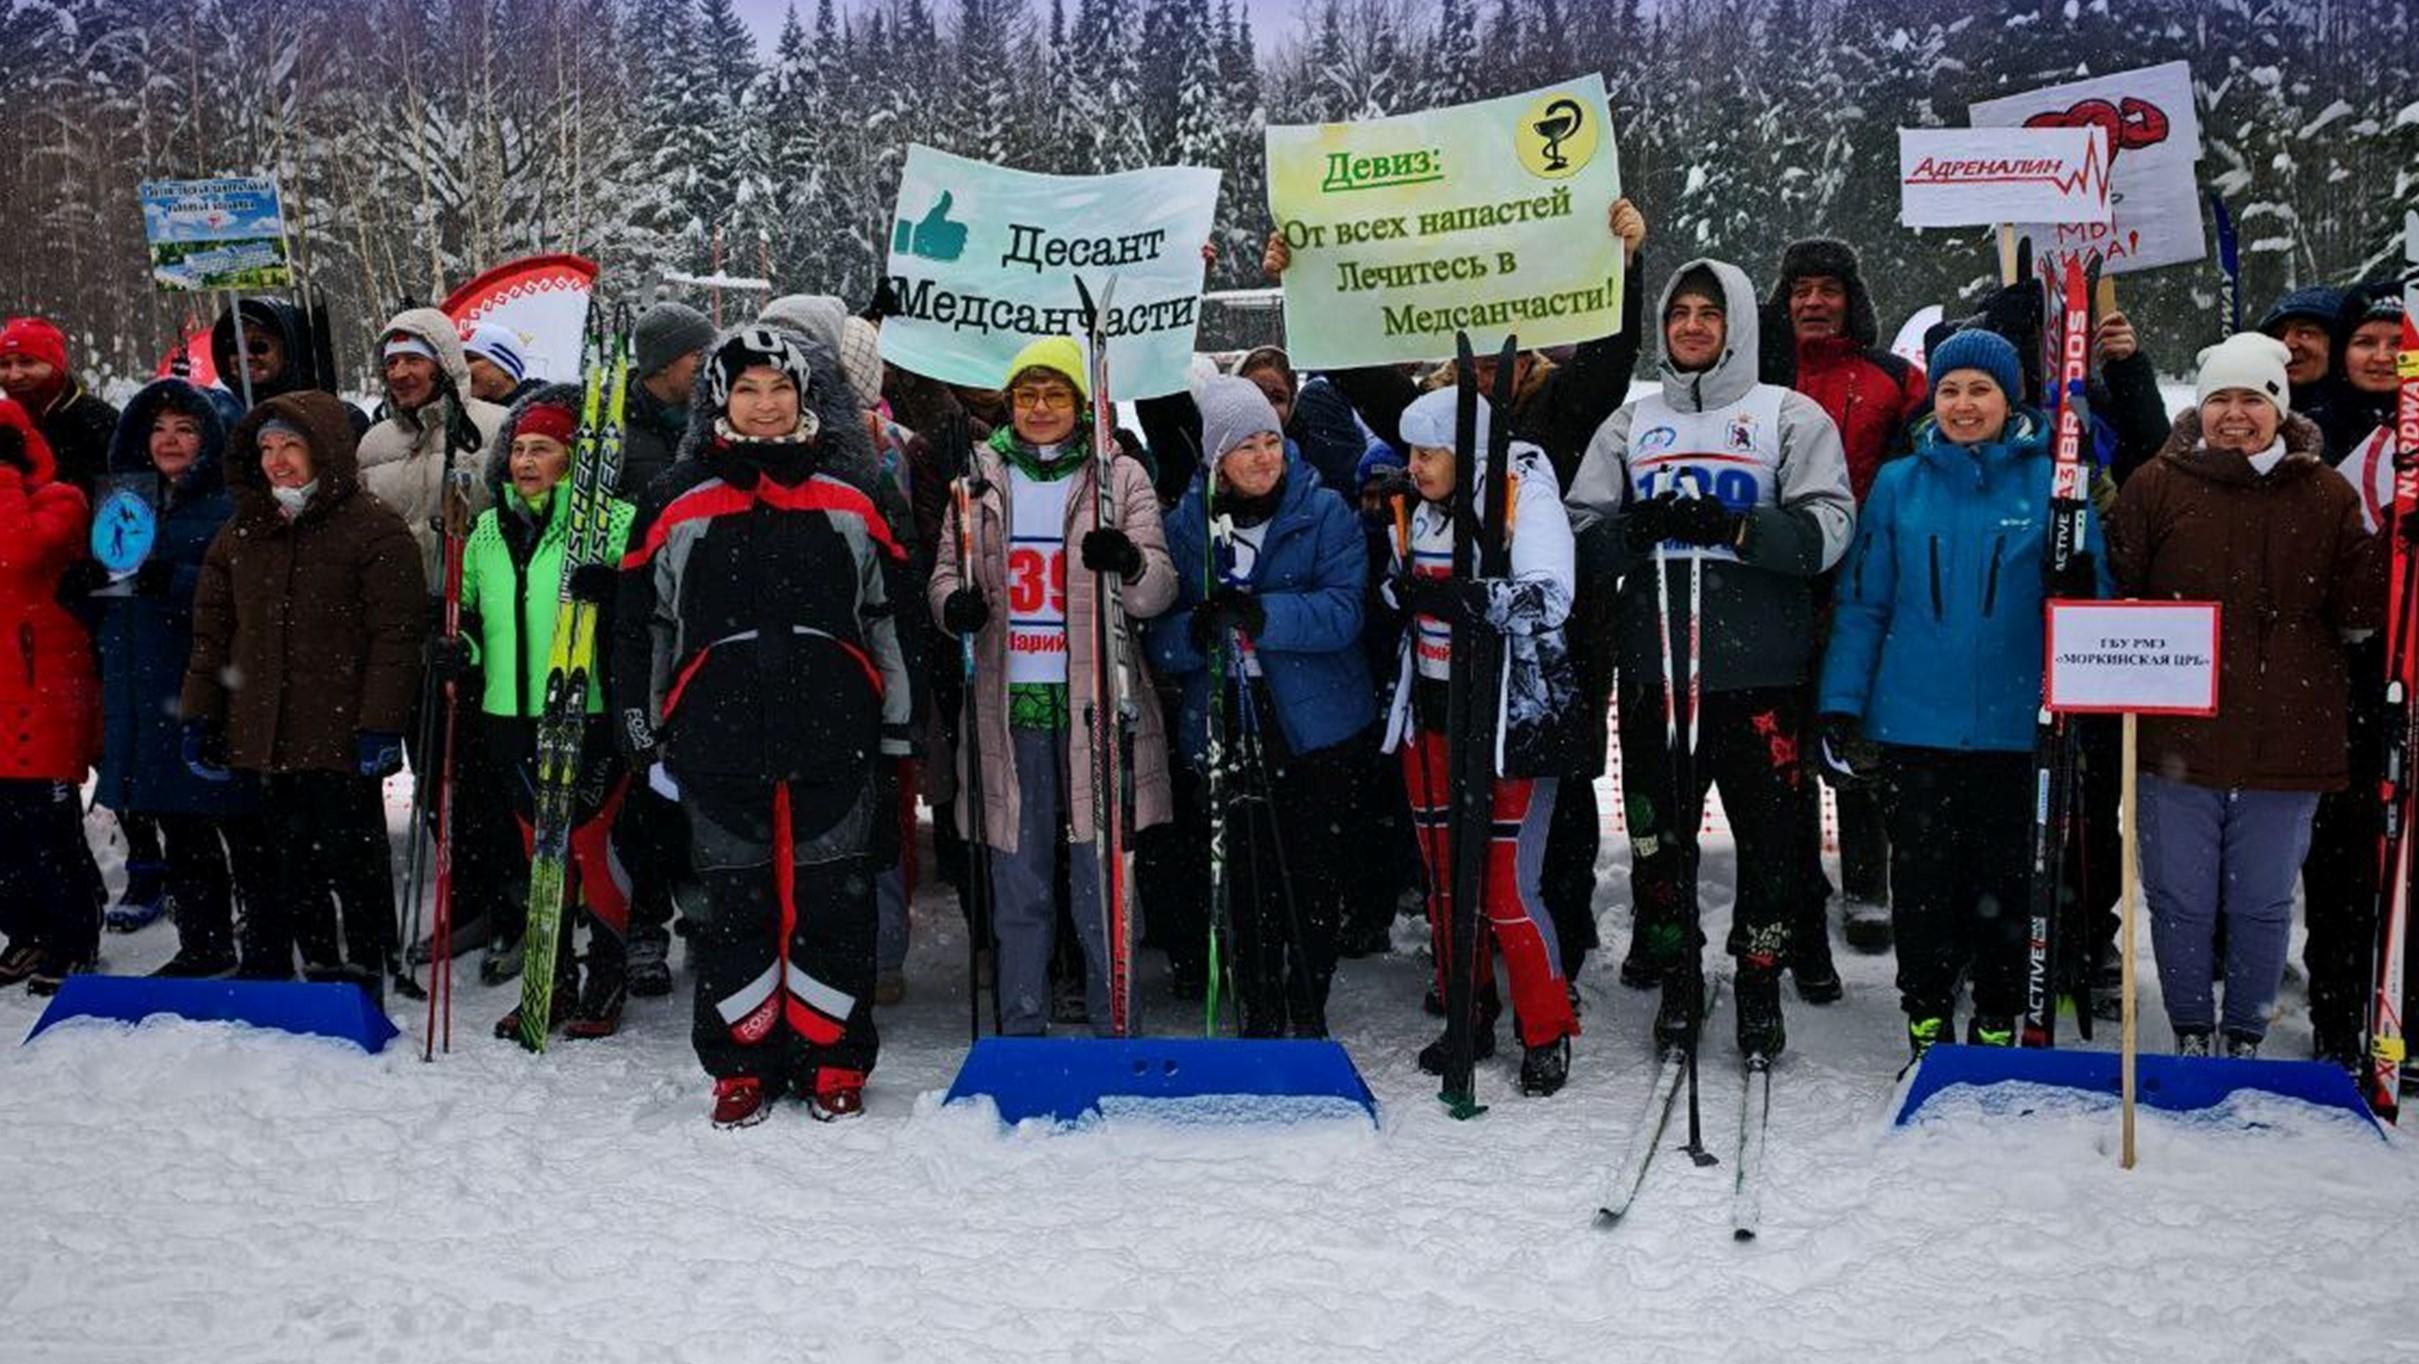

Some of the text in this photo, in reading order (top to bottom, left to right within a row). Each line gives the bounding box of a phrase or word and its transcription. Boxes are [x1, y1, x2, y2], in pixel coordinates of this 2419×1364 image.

[1321, 147, 1443, 192] Девиз:
[1001, 223, 1166, 275] Десант
[1283, 184, 1573, 251] От всех напастей
[1336, 250, 1518, 292] Лечитесь в
[891, 275, 1199, 341] Медсанчасти
[1382, 276, 1615, 337] Медсанчасти!
[2058, 309, 2088, 461] BRDOS
[586, 443, 618, 563] ISCHER
[1010, 630, 1067, 654] арий
[2029, 945, 2046, 1026] ACTIVE
